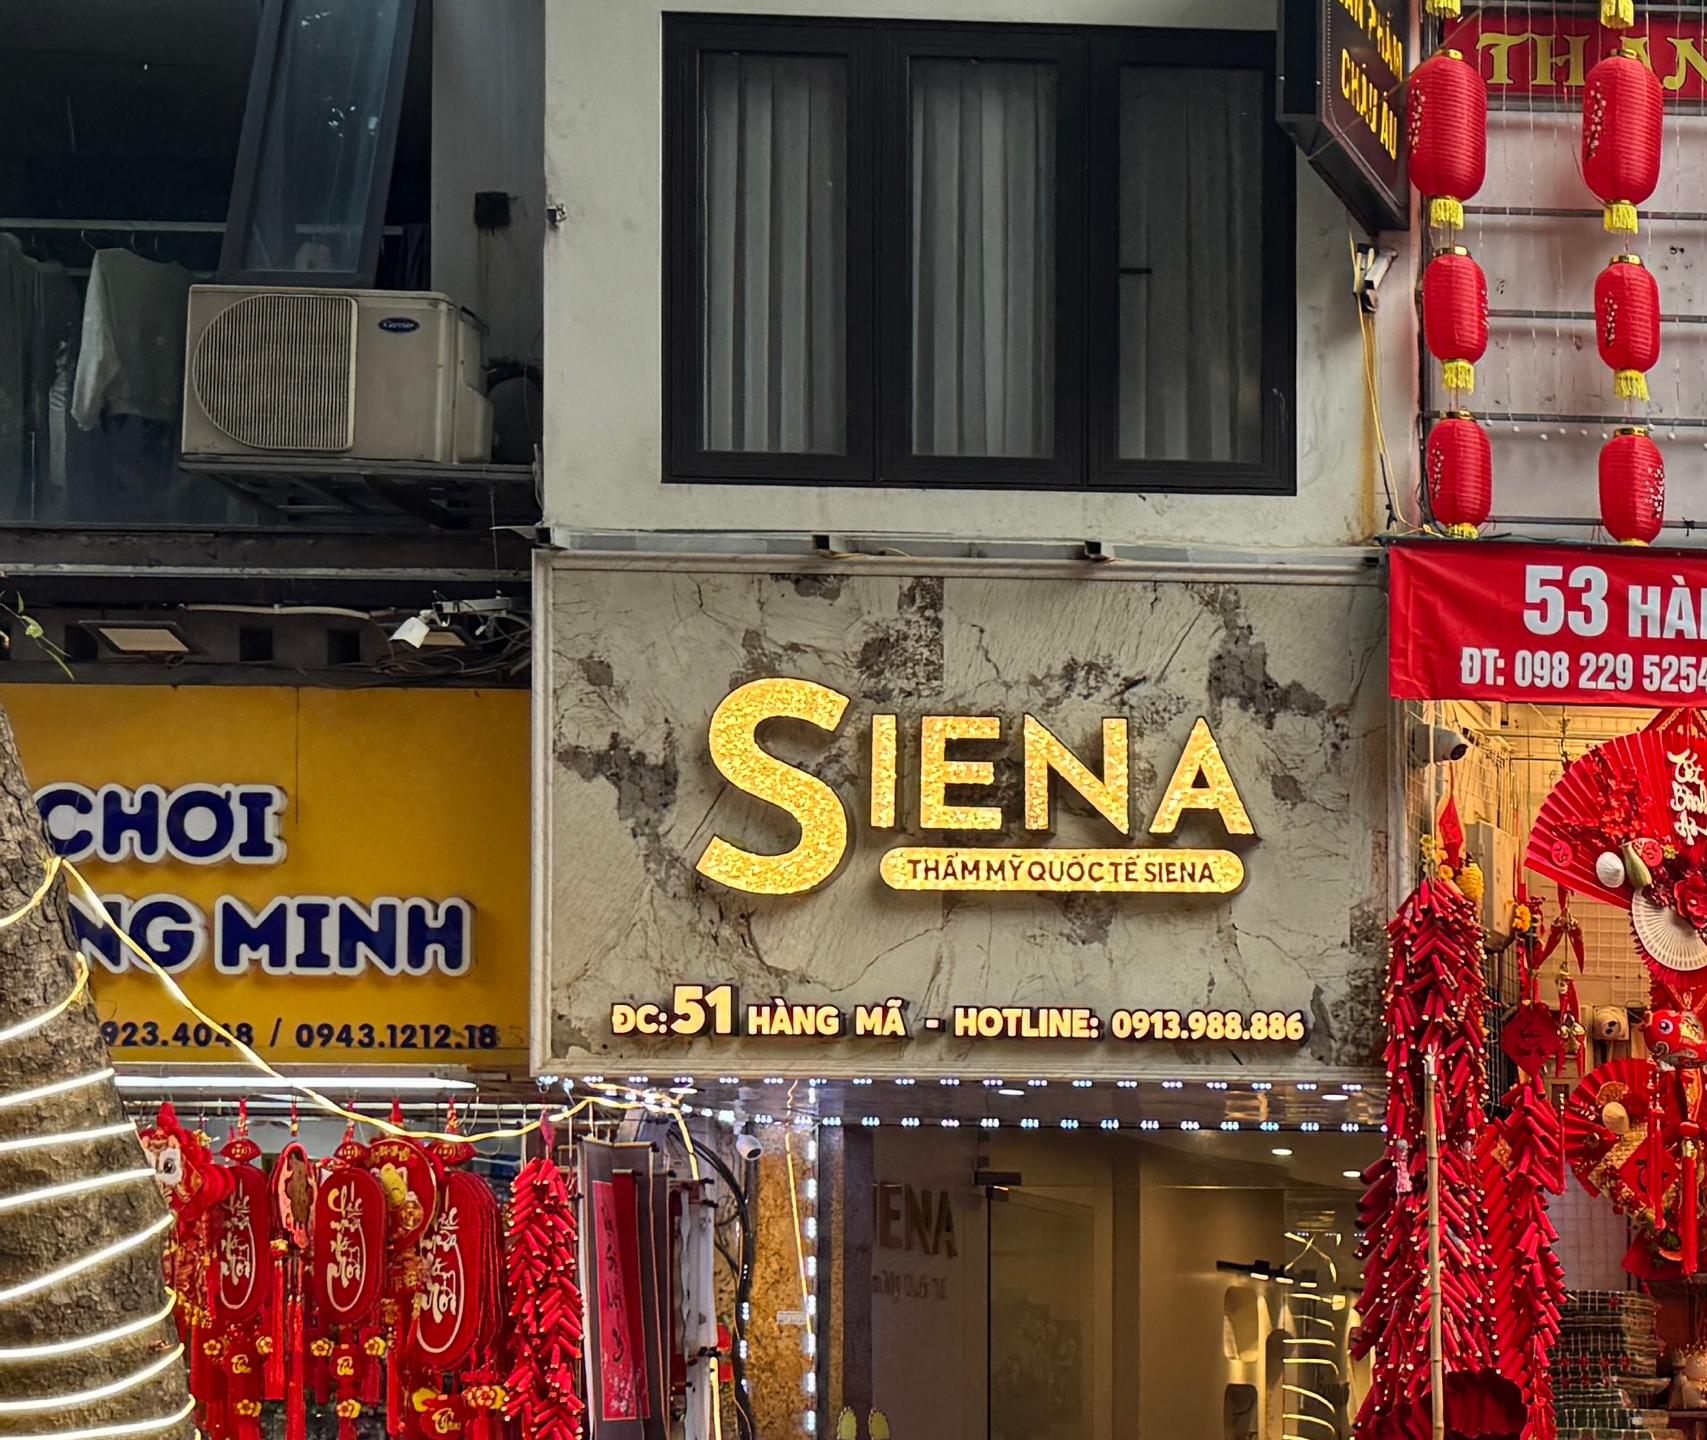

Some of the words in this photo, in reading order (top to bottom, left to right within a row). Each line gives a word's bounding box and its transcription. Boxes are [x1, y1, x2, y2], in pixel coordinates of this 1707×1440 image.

[1522, 565, 1607, 637] 53
[1461, 647, 1506, 687] ĐT:
[1514, 651, 1569, 690] 098
[1578, 652, 1634, 692] 229
[695, 677, 1256, 895] SIENA
[39, 788, 276, 858] CHƠI
[907, 852, 981, 882] THẨM
[986, 854, 1022, 882] MỸ
[1027, 853, 1105, 882] QUỐC
[1109, 854, 1139, 883] TẾ
[1144, 861, 1216, 884] SIENA
[221, 901, 464, 970] MINH
[612, 1004, 668, 1036] ĐC:
[671, 984, 733, 1035] 51
[747, 999, 839, 1037] HÀNG
[856, 997, 907, 1037] MÃ
[954, 1007, 1099, 1039] HOTLINE:
[1112, 1010, 1304, 1041] 0913.988.886
